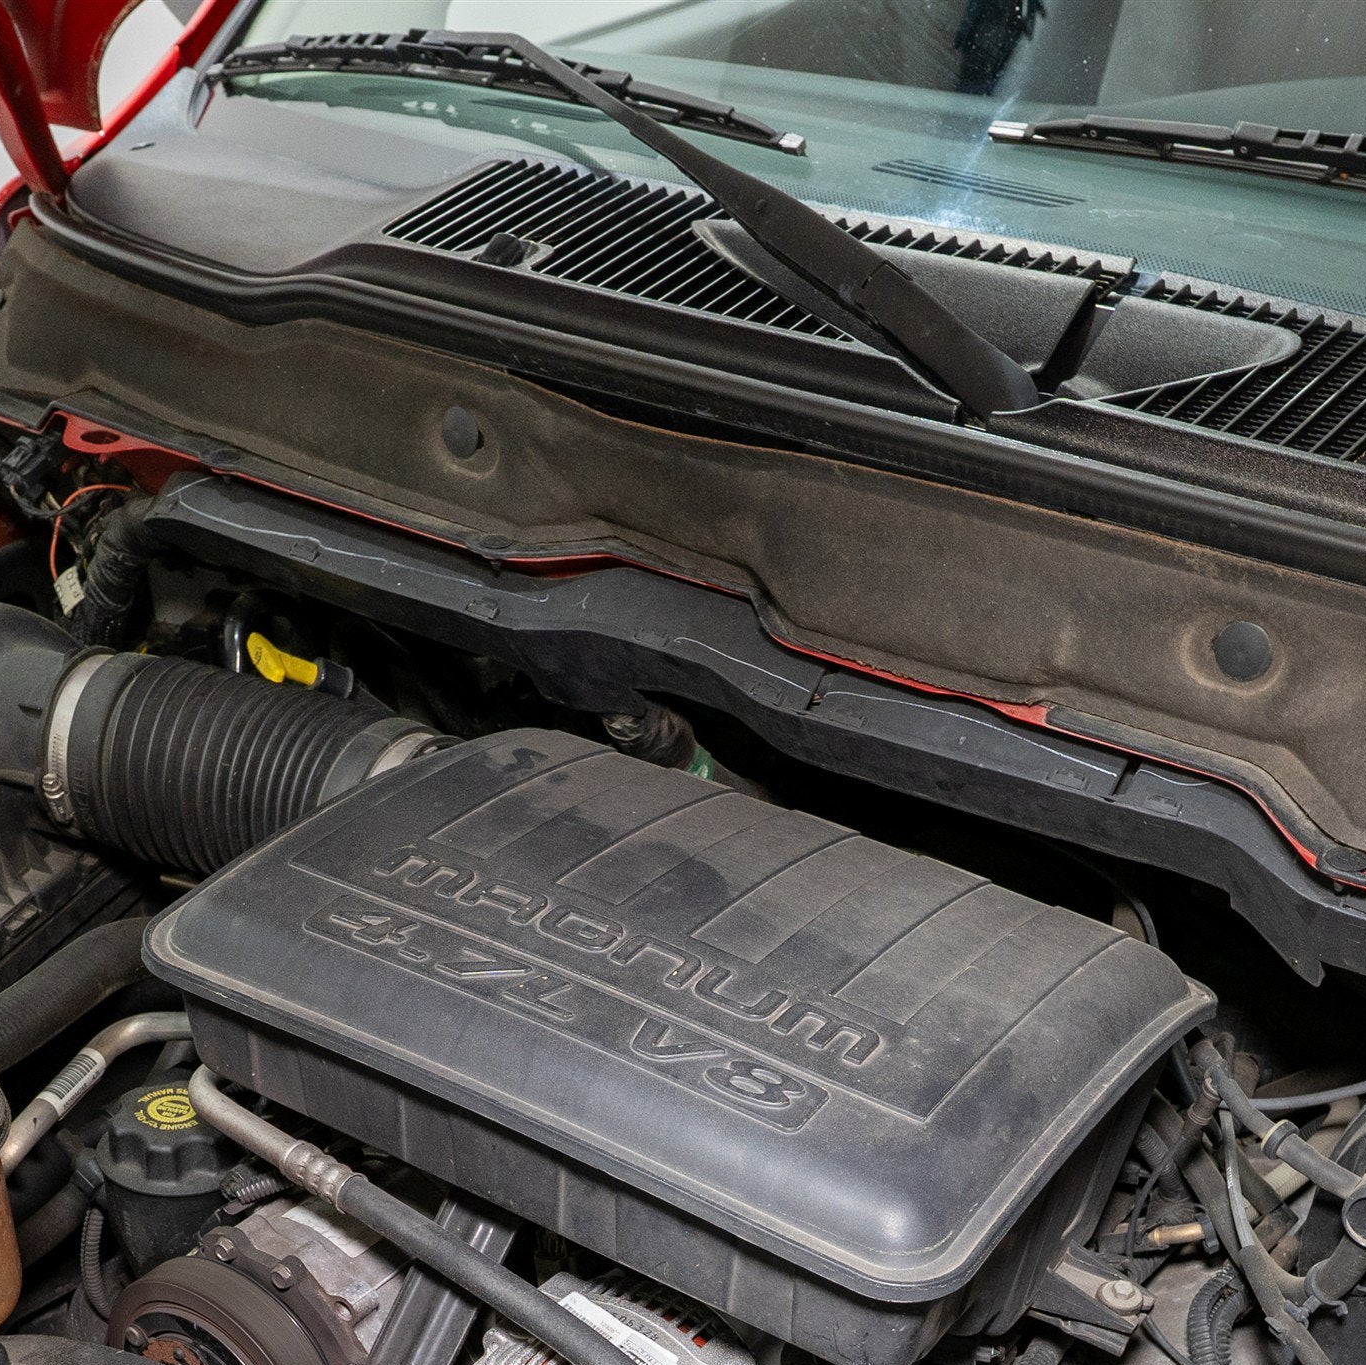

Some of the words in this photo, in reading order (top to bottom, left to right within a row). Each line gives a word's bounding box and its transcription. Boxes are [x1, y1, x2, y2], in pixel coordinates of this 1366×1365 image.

[327, 908, 574, 1022] 4.7L
[630, 1016, 808, 1109] V8
[373, 846, 885, 1069] MAGNUM
[159, 1119, 199, 1131] ENGINE
